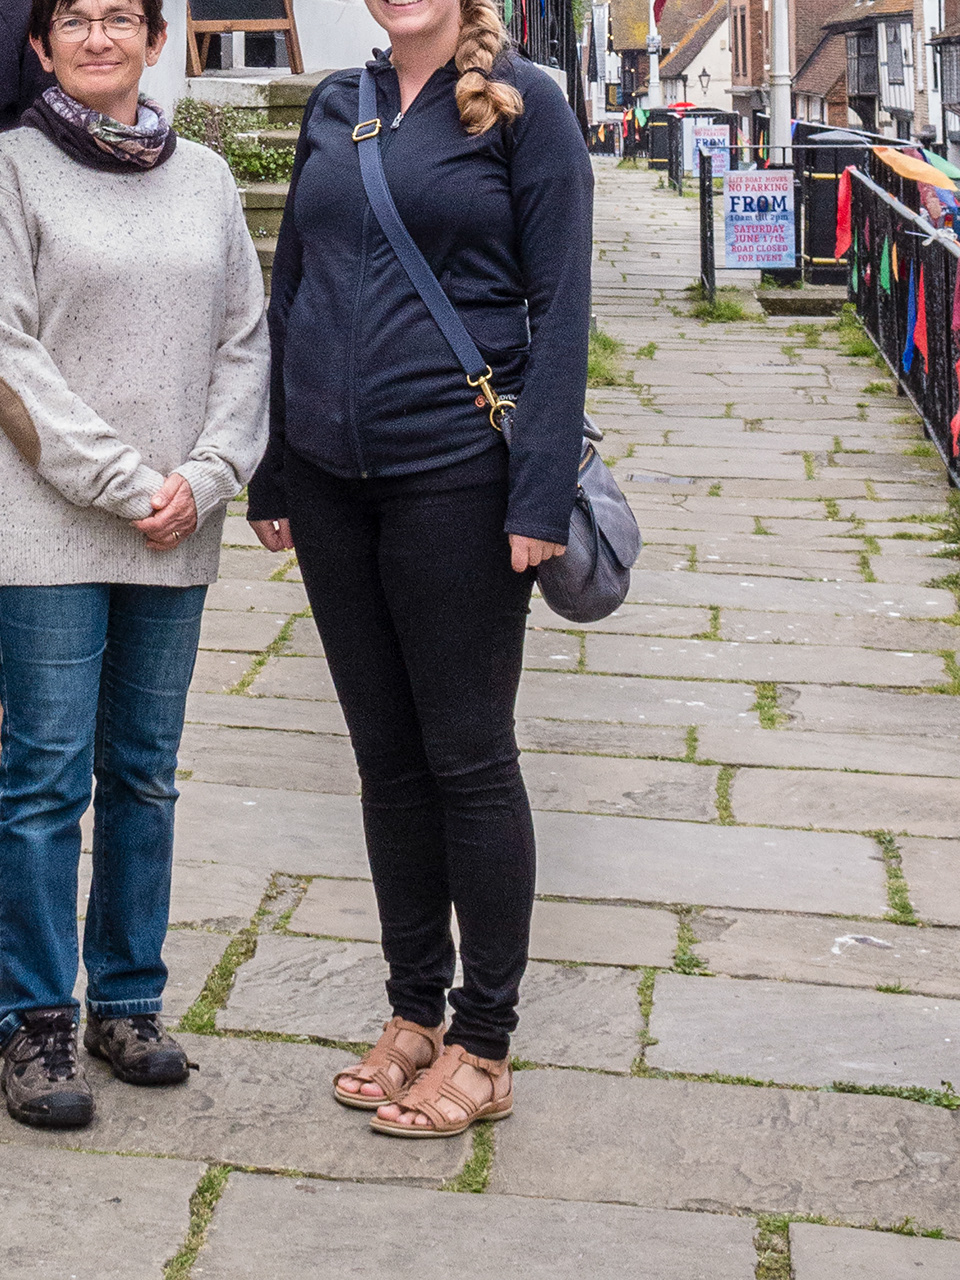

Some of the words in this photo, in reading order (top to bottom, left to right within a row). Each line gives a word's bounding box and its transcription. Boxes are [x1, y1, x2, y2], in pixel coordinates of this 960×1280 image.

[695, 138, 725, 147] FROM
[728, 183, 742, 192] NO
[745, 183, 788, 192] PARKING
[729, 195, 788, 213] FROM
[733, 224, 785, 234] SATURDAY
[734, 234, 760, 243] JUNE
[763, 234, 785, 243] 17th
[731, 244, 754, 253] ROAD
[756, 244, 789, 252] CLOSED
[737, 254, 754, 262] FOR
[756, 254, 783, 262] EVENT
